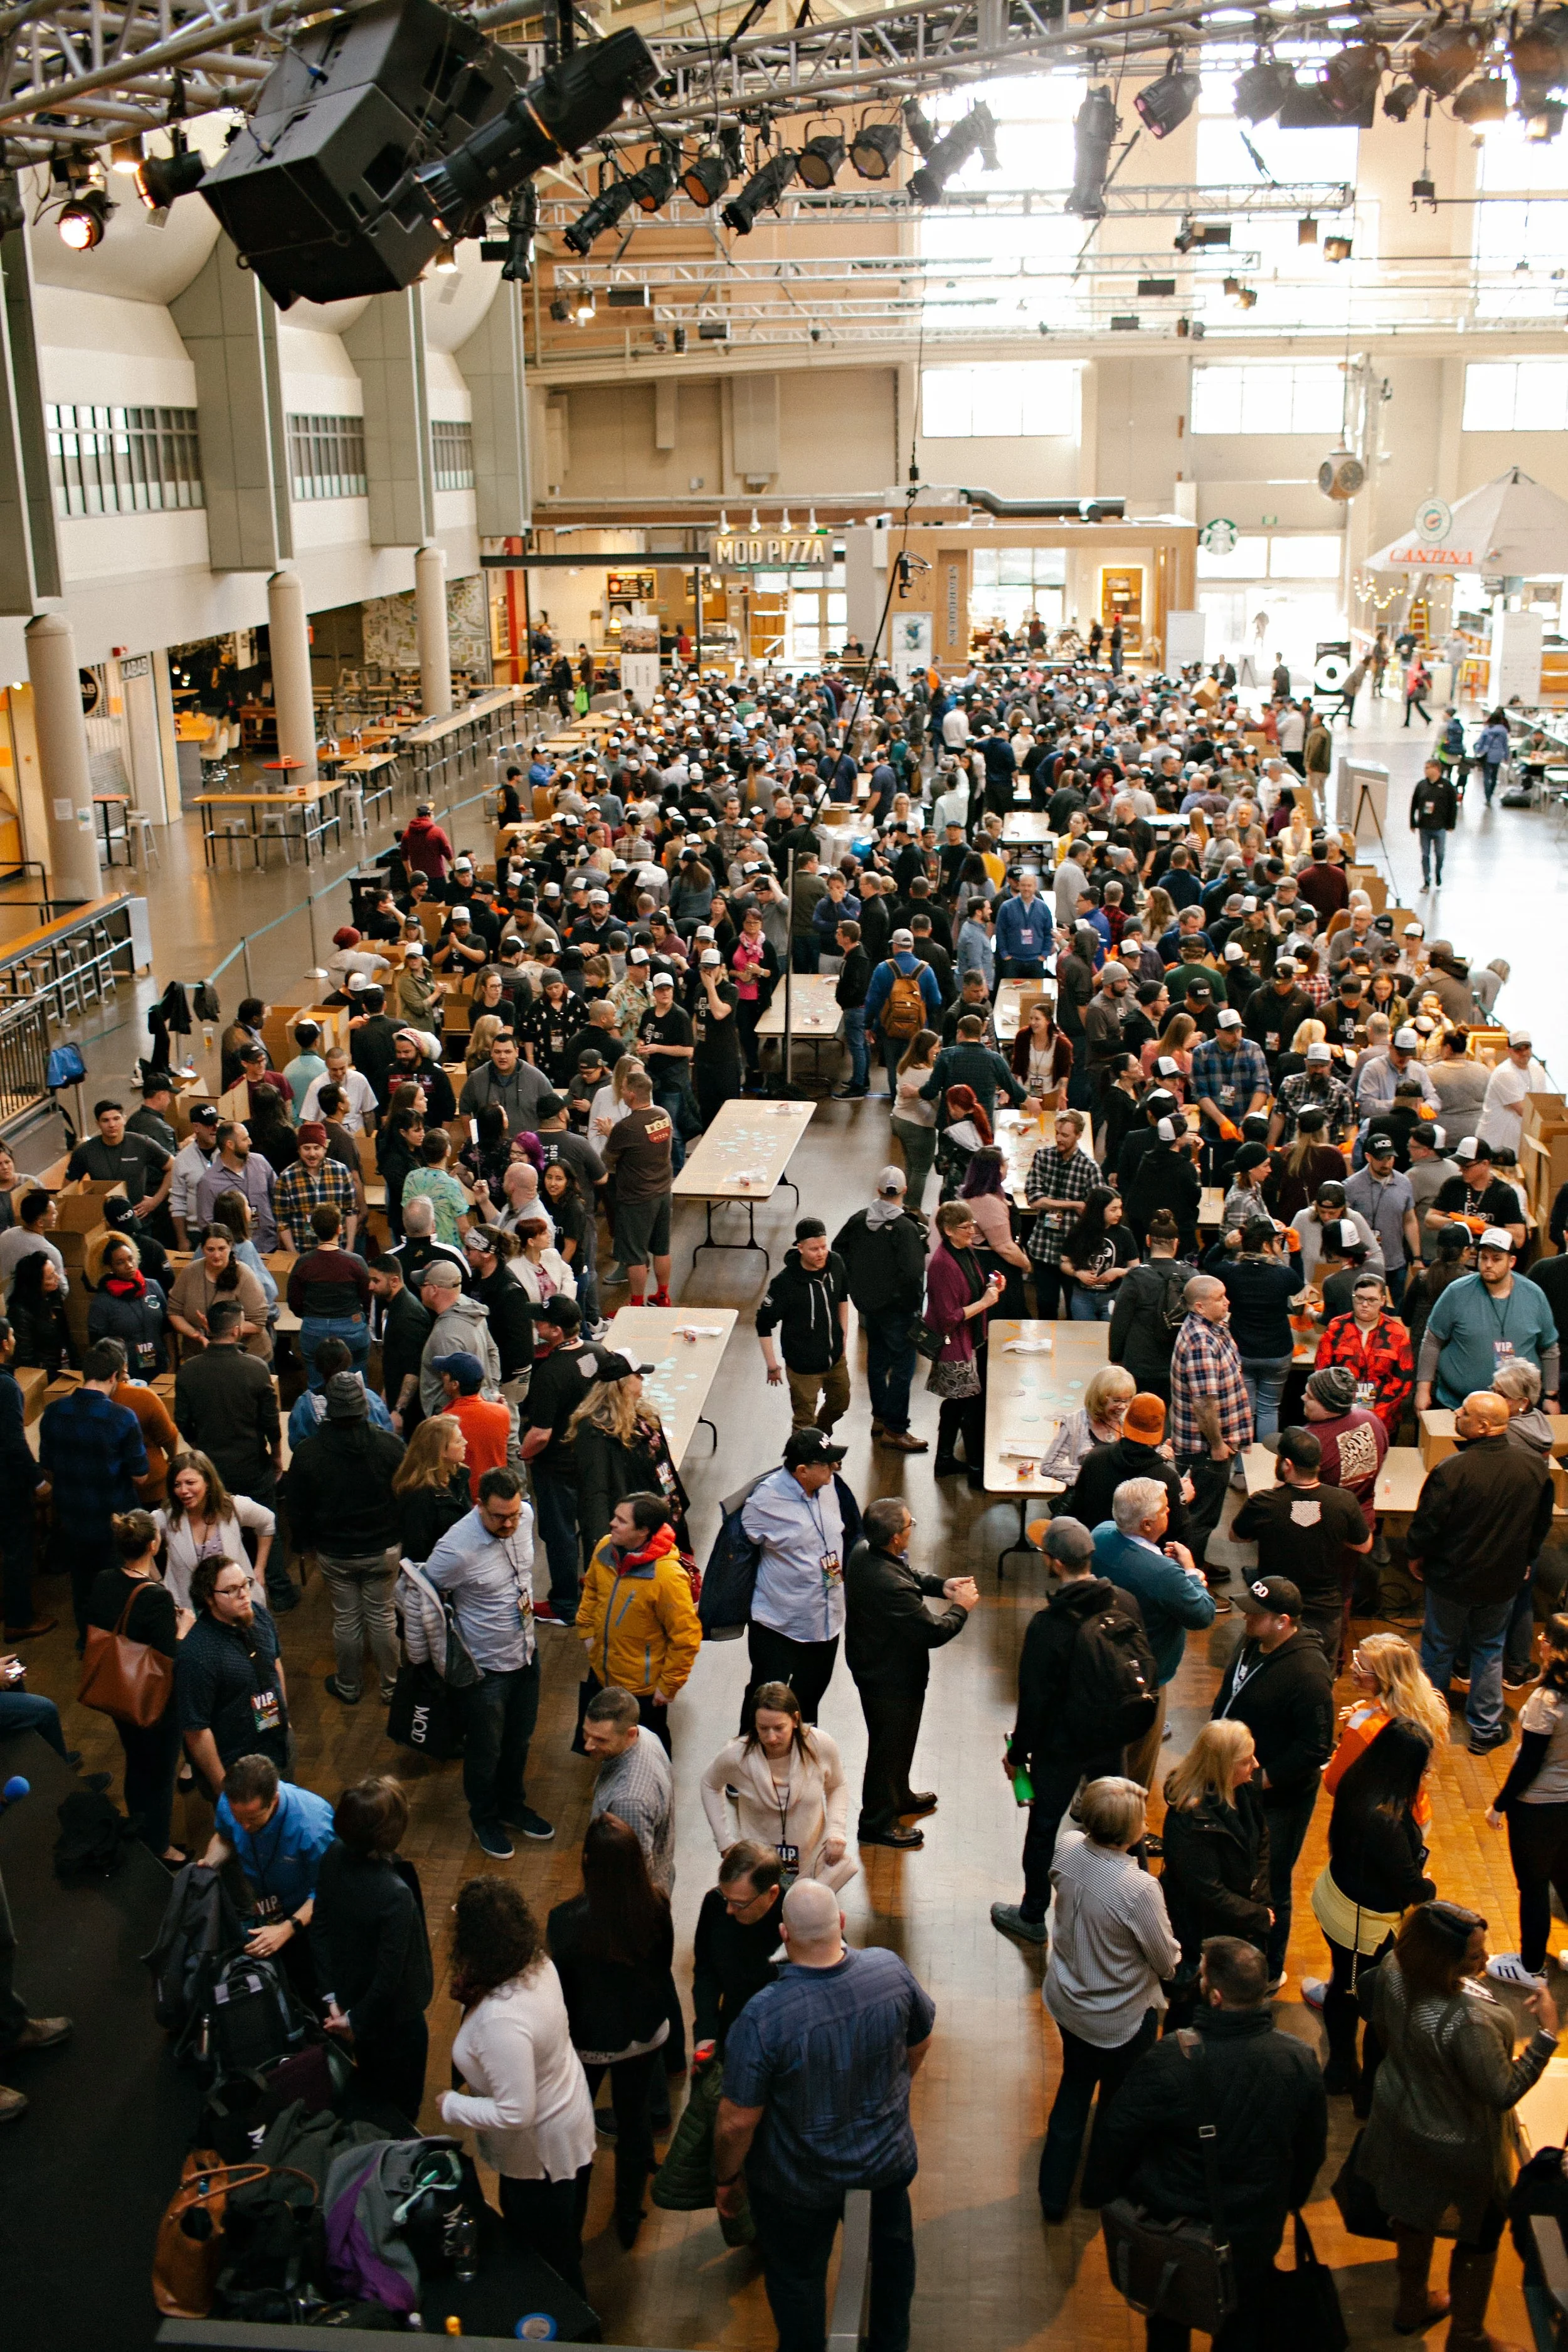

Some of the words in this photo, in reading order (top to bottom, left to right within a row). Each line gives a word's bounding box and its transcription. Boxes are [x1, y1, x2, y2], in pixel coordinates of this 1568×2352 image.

[716, 539, 763, 565] MOD
[767, 539, 825, 564] PIZZA
[1389, 548, 1473, 565] CANTINA
[948, 565, 958, 646] STARBUCKS
[649, 1120, 667, 1132] MOD
[1495, 1342, 1513, 1352] VIP
[1357, 1382, 1374, 1393] VIP
[819, 1553, 837, 1569] VIP
[1251, 1581, 1269, 1598] OD
[252, 1692, 274, 1710] VIP
[411, 1704, 431, 1744] MOD
[256, 1895, 278, 1915] VIP
